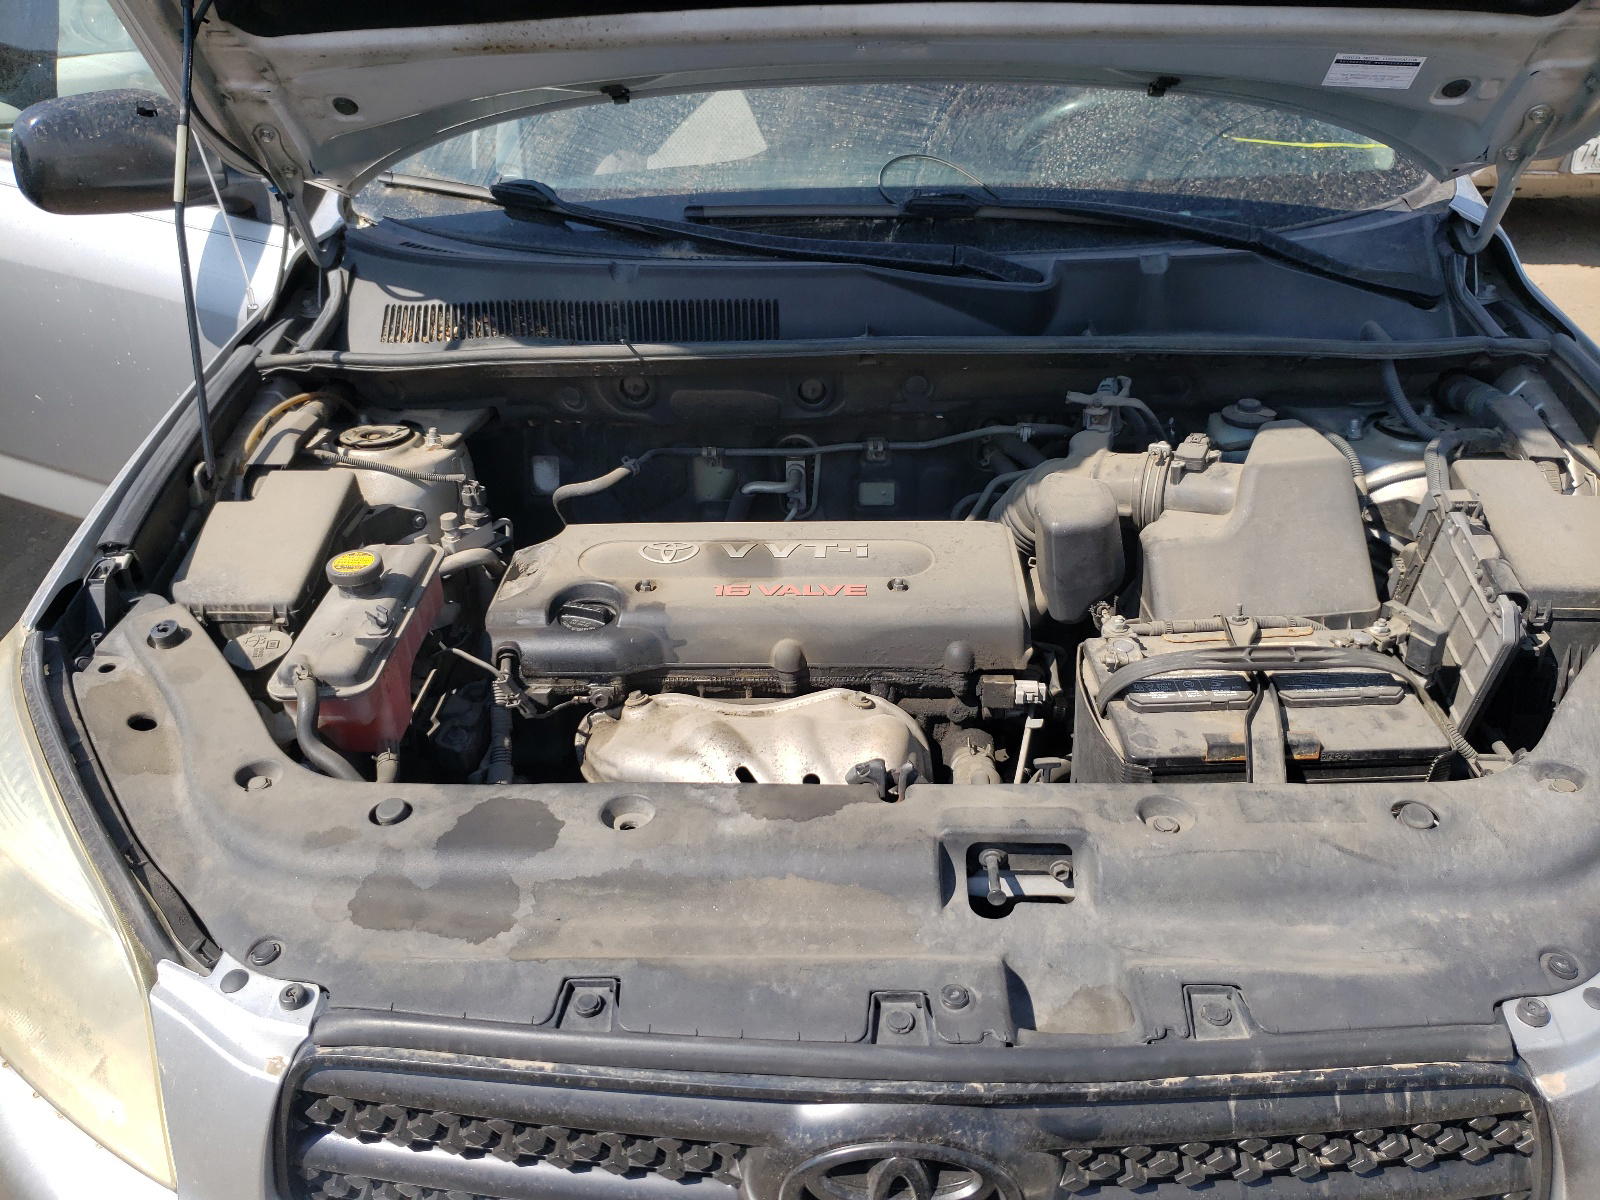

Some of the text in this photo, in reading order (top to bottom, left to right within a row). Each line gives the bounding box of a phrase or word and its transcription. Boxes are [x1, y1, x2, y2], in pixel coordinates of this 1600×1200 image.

[721, 543, 869, 559] VVT-i
[713, 584, 868, 597] 16 VALVE
